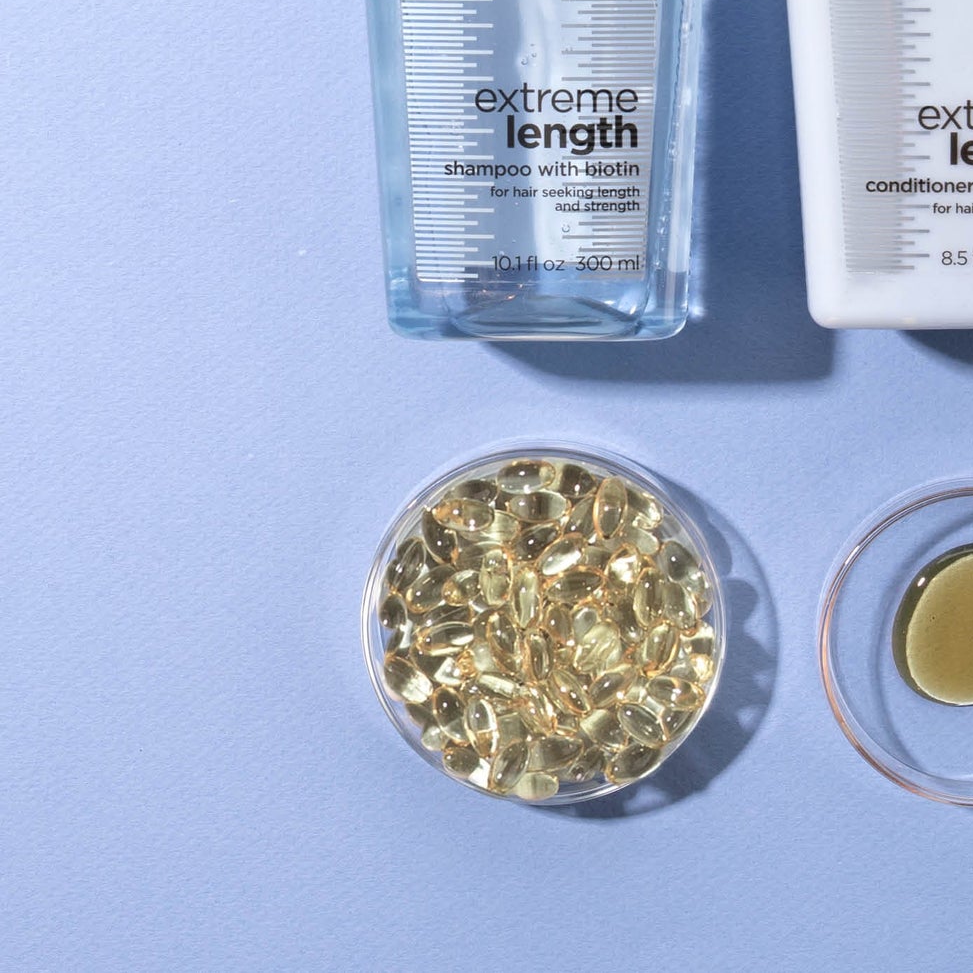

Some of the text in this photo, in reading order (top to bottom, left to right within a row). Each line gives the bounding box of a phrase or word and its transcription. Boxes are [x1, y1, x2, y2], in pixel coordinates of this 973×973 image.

[475, 82, 639, 113] extreme
[507, 114, 639, 156] length
[444, 160, 640, 178] shampoo with biotin
[490, 186, 640, 200] for hair seeking length
[555, 200, 640, 214] and strength
[933, 202, 952, 214] for
[492, 255, 640, 272] 10.1 fl oz 300 ml
[941, 250, 968, 266] 8.5
